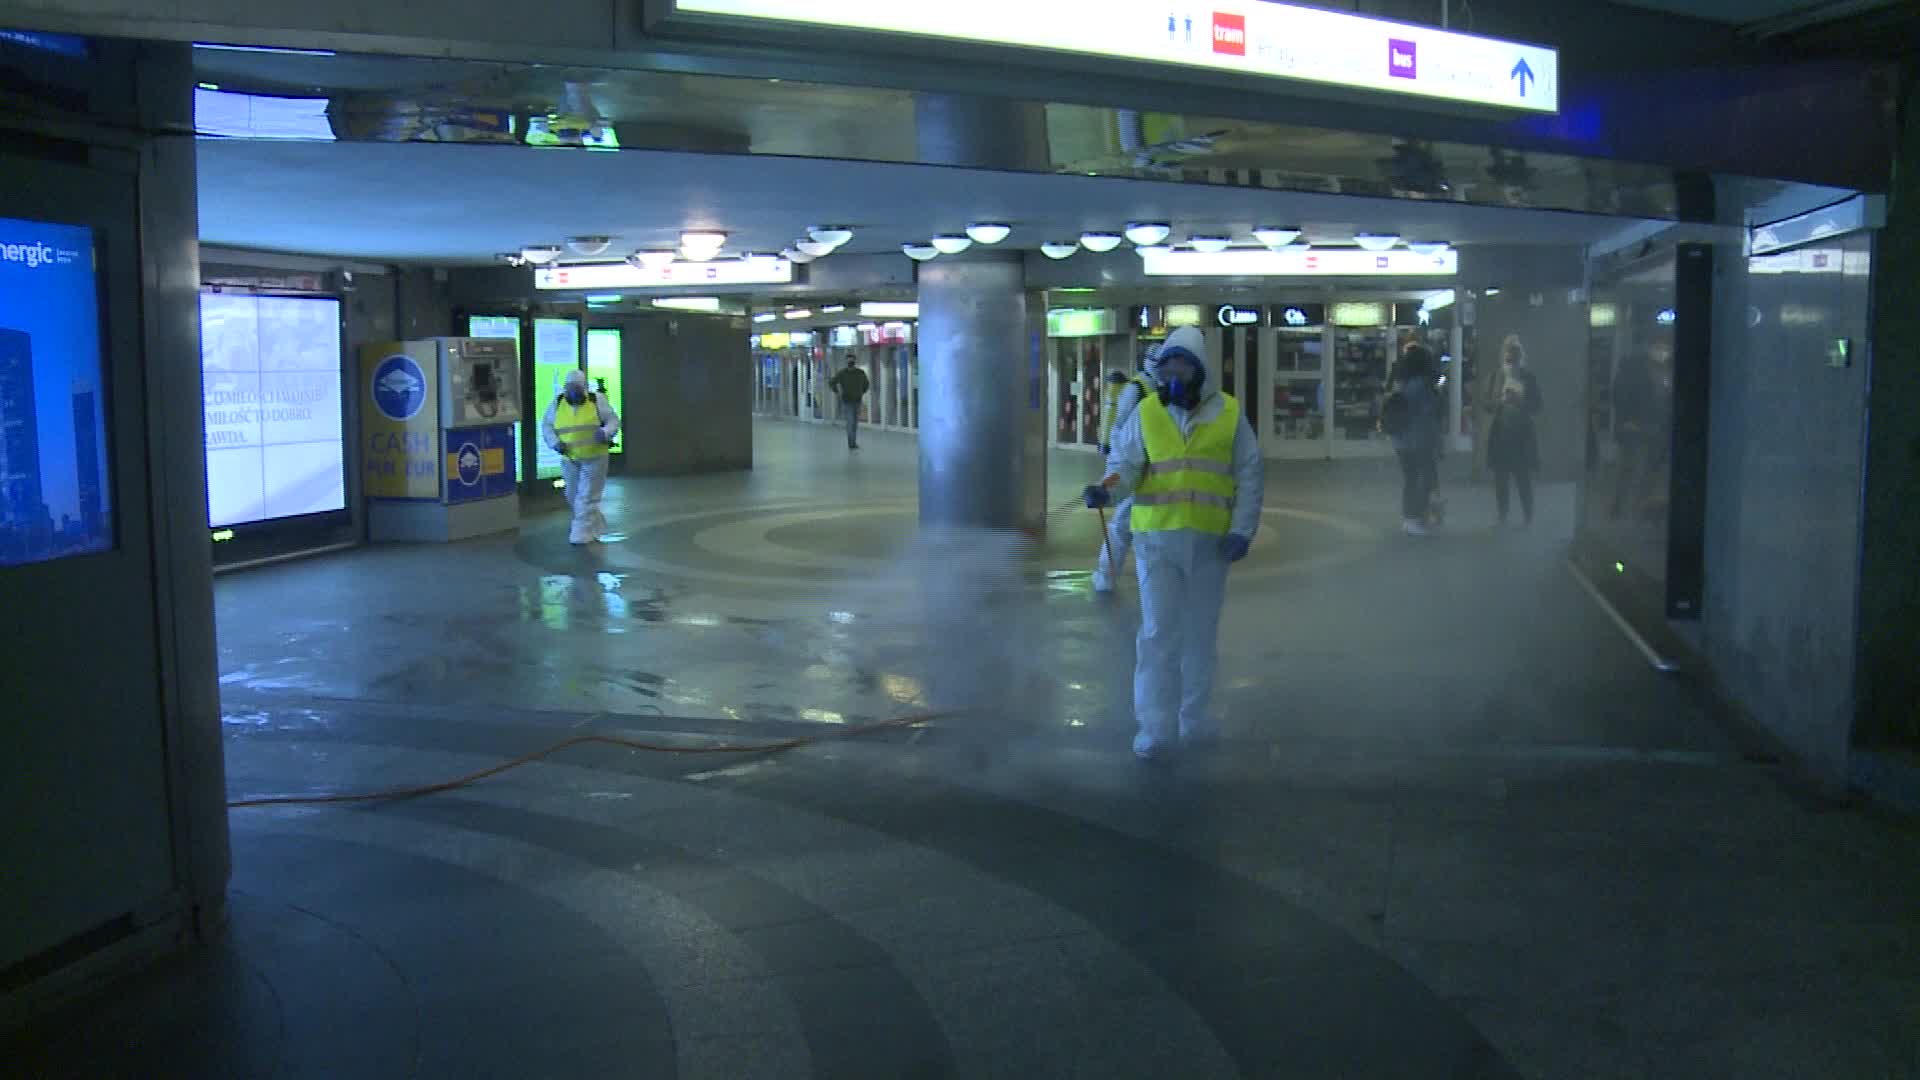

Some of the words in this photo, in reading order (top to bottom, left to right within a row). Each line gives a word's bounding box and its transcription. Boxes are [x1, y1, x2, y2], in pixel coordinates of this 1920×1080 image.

[1214, 24, 1244, 45] tram
[1393, 47, 1413, 69] bus
[370, 432, 430, 455] CASH
